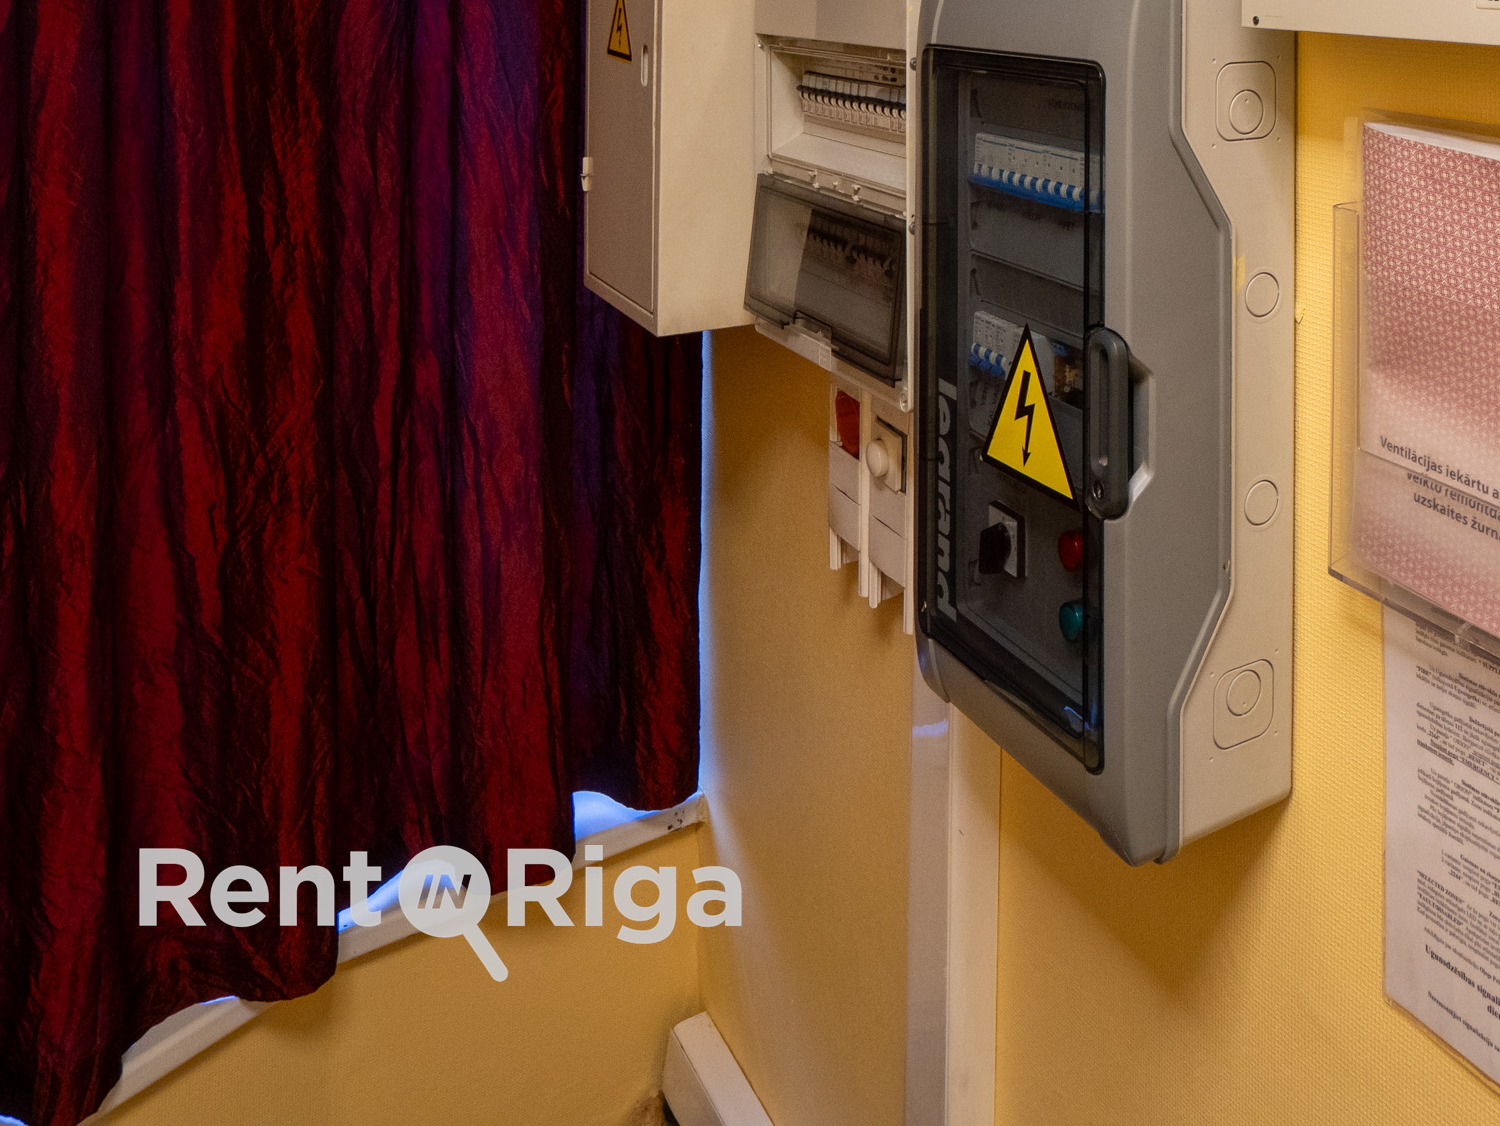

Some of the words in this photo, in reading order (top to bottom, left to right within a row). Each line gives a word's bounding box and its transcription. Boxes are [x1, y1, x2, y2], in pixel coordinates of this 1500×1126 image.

[1380, 435, 1443, 475] Ventilācijas
[1446, 464, 1489, 495] iekārtu
[1413, 492, 1468, 526] uzskaites
